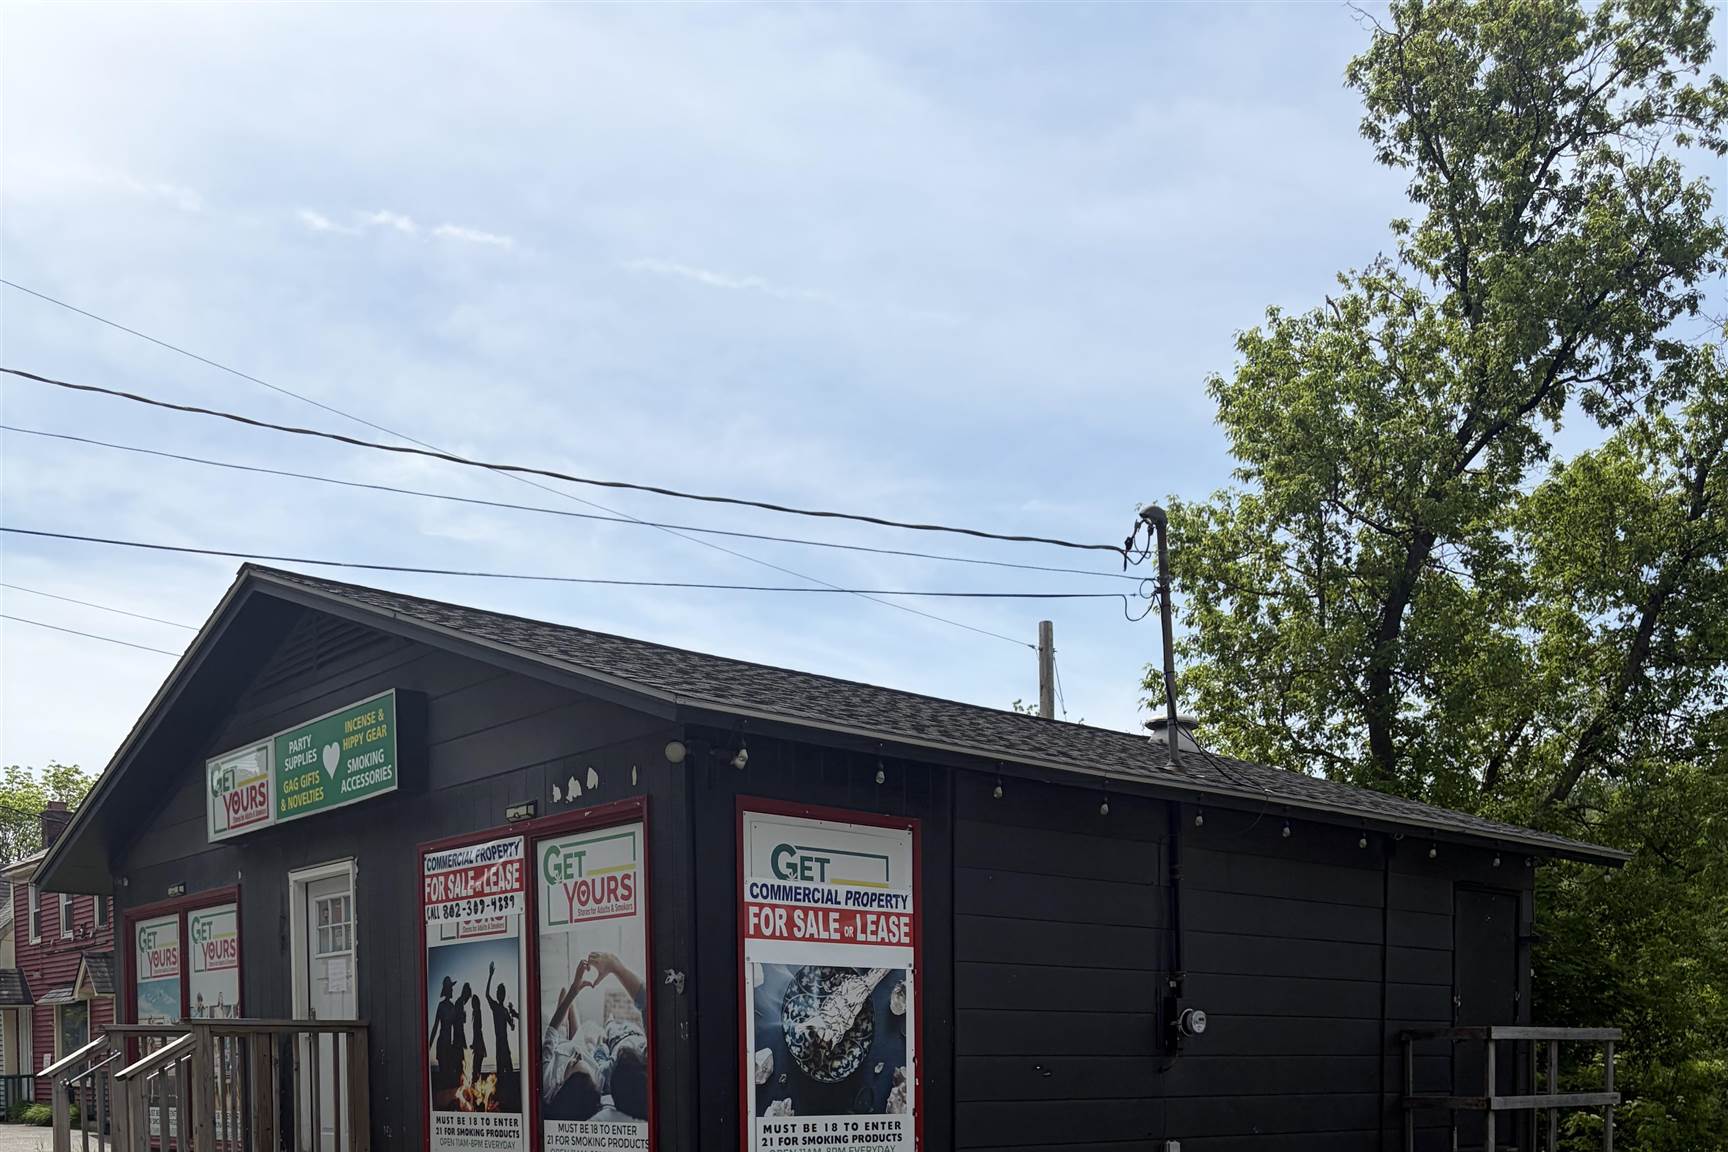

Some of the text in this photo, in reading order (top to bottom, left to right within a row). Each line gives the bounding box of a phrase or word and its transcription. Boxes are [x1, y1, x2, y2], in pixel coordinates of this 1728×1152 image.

[344, 708, 385, 733] INCENSE &
[288, 734, 312, 754] PARTY
[343, 724, 388, 751] HIPPY GEAR
[284, 748, 318, 772] SUPPLIES
[347, 749, 385, 774] SMOKING
[211, 763, 237, 798] GET
[283, 770, 320, 794] GAG GIFTS
[341, 765, 393, 794] ACCESSORIES
[223, 782, 267, 830] YOURS
[280, 786, 325, 812] & NOVELTIES
[426, 840, 521, 872] COMMERCIAL PROPERTY
[543, 845, 587, 886] GET
[770, 843, 831, 883] GET
[424, 875, 446, 903] FOR
[447, 870, 475, 900] SALE
[483, 862, 520, 894] LEASE
[749, 882, 909, 910] COMMERCIAL PROPERTY
[563, 873, 633, 924] YOURS
[191, 916, 213, 944] GET
[748, 906, 789, 937] FOR
[793, 910, 841, 940] SALE
[855, 913, 910, 944] LEASE
[138, 926, 157, 953] GET
[147, 947, 177, 977] YOURS
[201, 938, 236, 972] YOURS
[435, 1115, 519, 1128] MUST BE 18 TO ENTER
[435, 1126, 520, 1140] 21 FOR SMOKING PRODUCTS
[558, 1123, 638, 1136] MUST BE 18 TO ENTER
[763, 1121, 902, 1134] MUST BE 18 TO ENTER
[440, 1137, 455, 1147] OPEN
[484, 1140, 516, 1150] EVERYDAY
[547, 1135, 649, 1149] 21 FOR SMOKING PRODUCTS
[762, 1133, 903, 1147] 21 FOR SMOKING PRODUCTS
